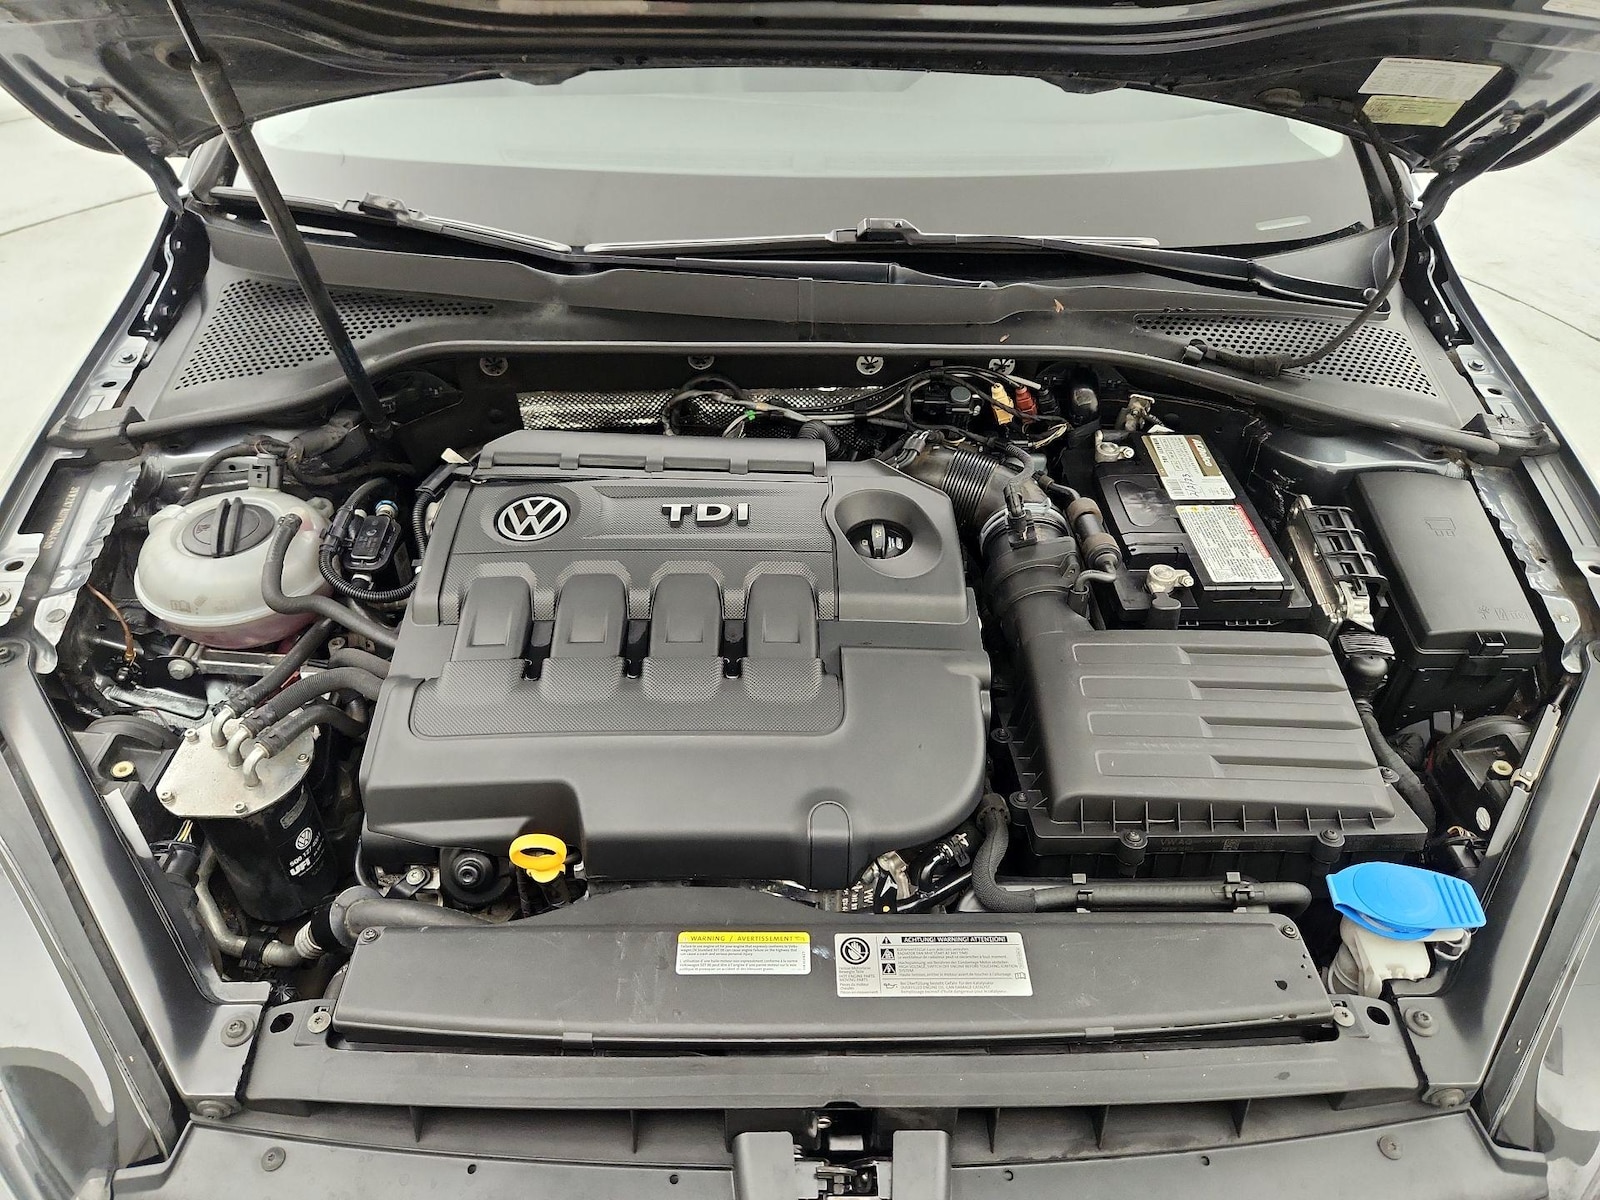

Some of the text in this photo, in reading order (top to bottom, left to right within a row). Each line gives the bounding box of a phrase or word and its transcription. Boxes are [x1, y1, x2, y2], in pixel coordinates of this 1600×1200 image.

[498, 496, 568, 541] VW
[661, 502, 750, 528] TDI
[289, 857, 311, 876] UFI
